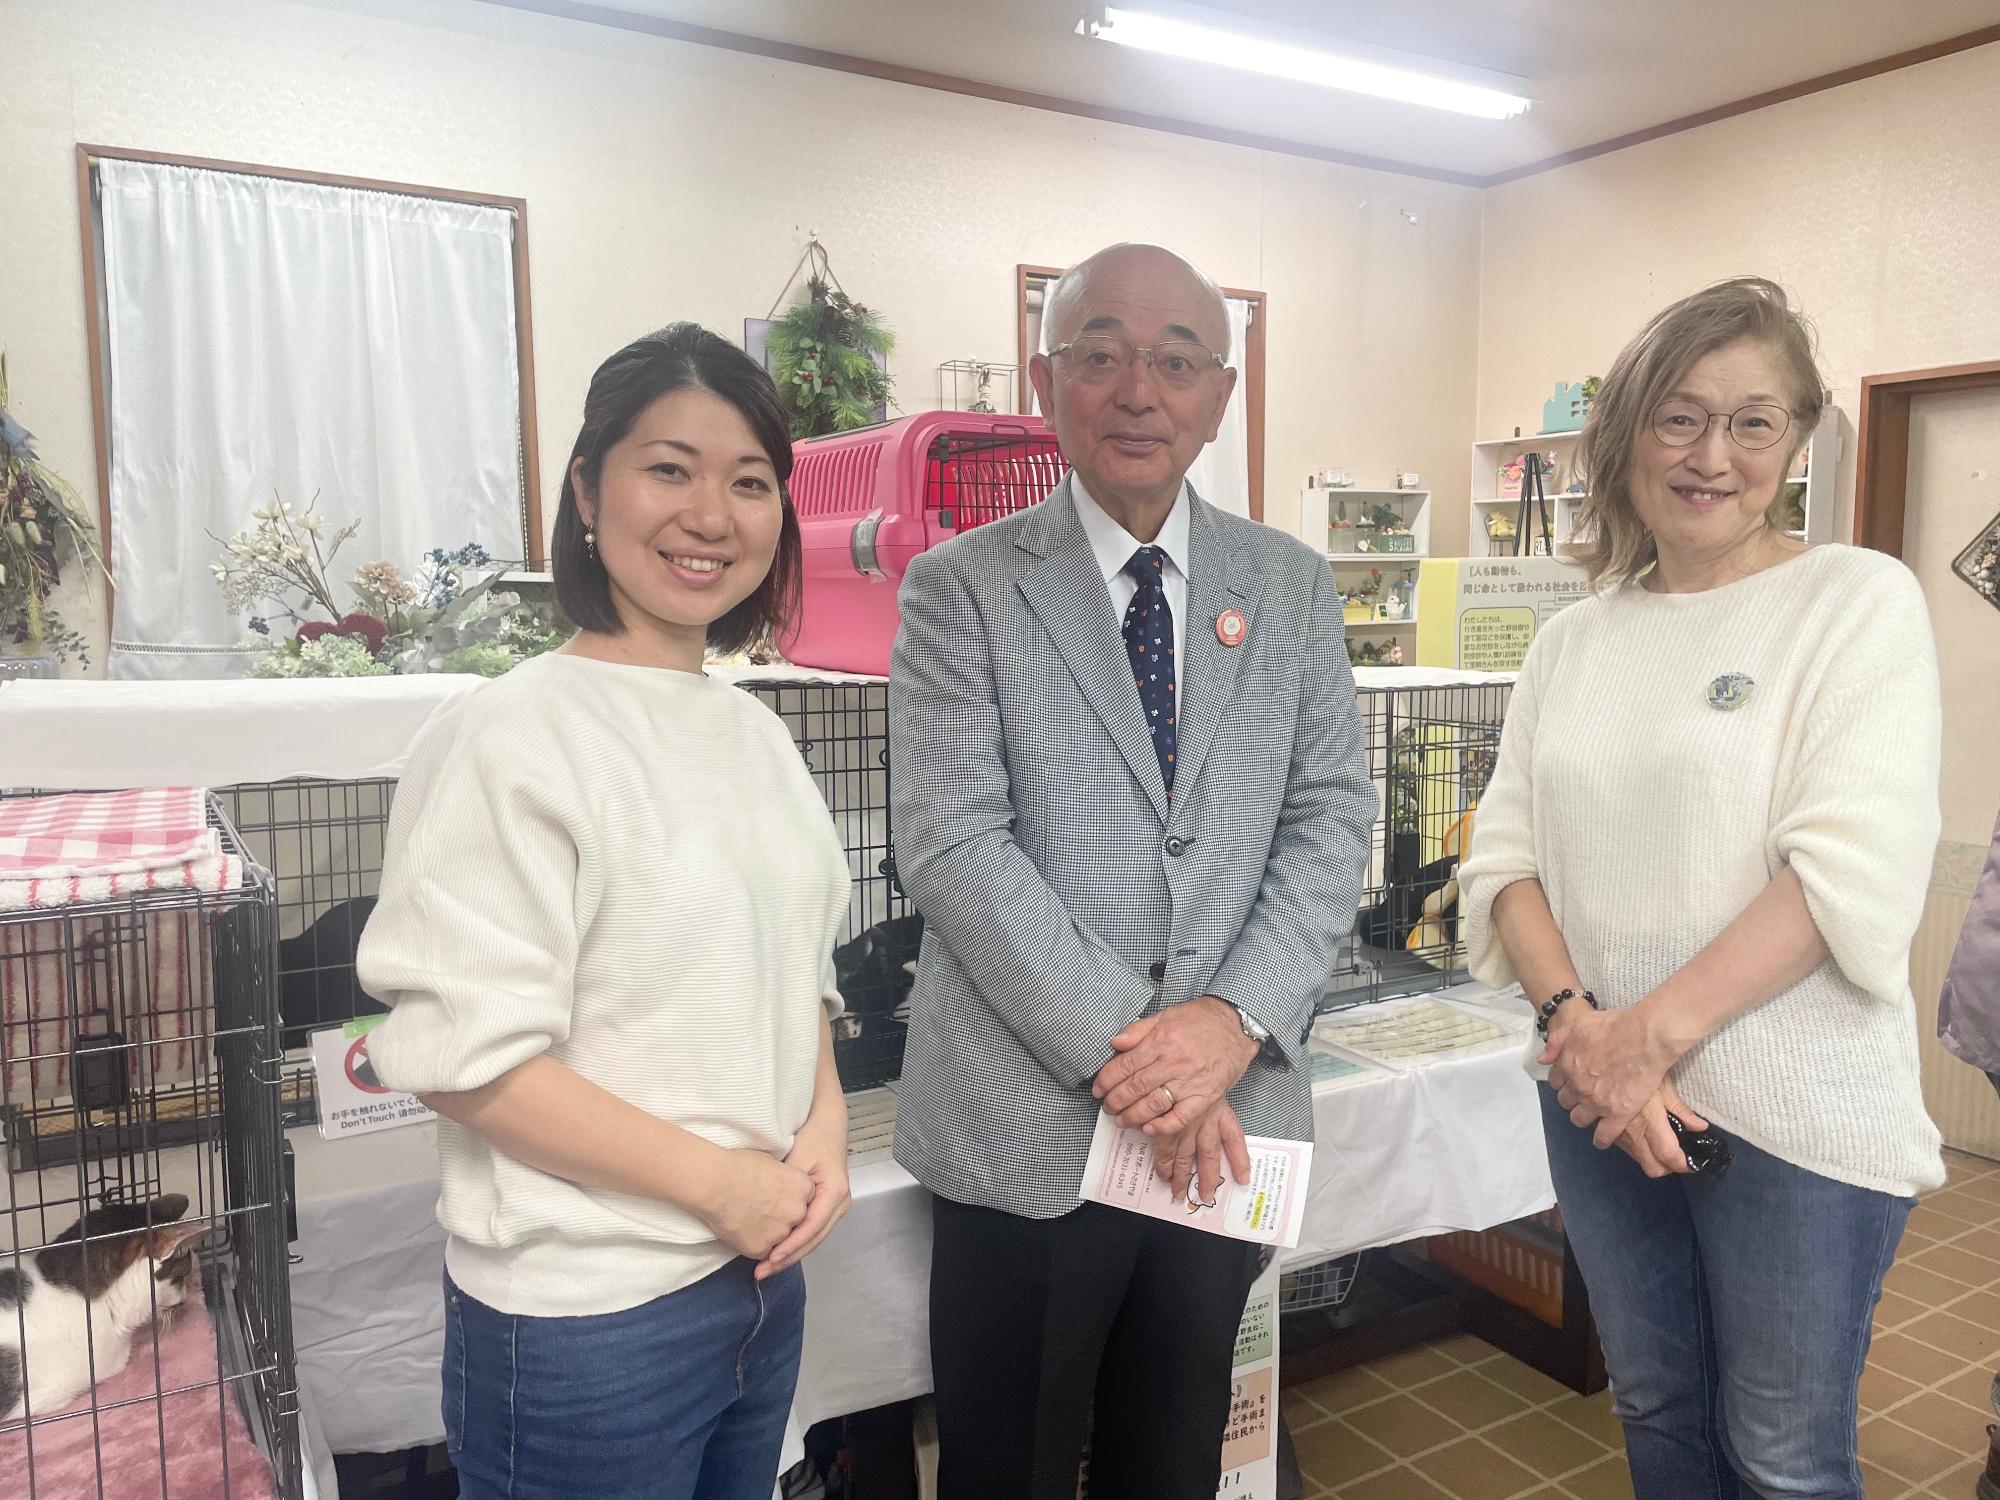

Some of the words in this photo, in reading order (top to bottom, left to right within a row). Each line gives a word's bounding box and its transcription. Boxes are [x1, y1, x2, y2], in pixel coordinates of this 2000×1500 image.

[341, 1116, 367, 1129] Don't
[368, 1112, 395, 1125] Touch
[398, 1106, 432, 1118] 请勿动
[1244, 1301, 1270, 1314] のための
[1238, 1323, 1264, 1335] 野良ねこ
